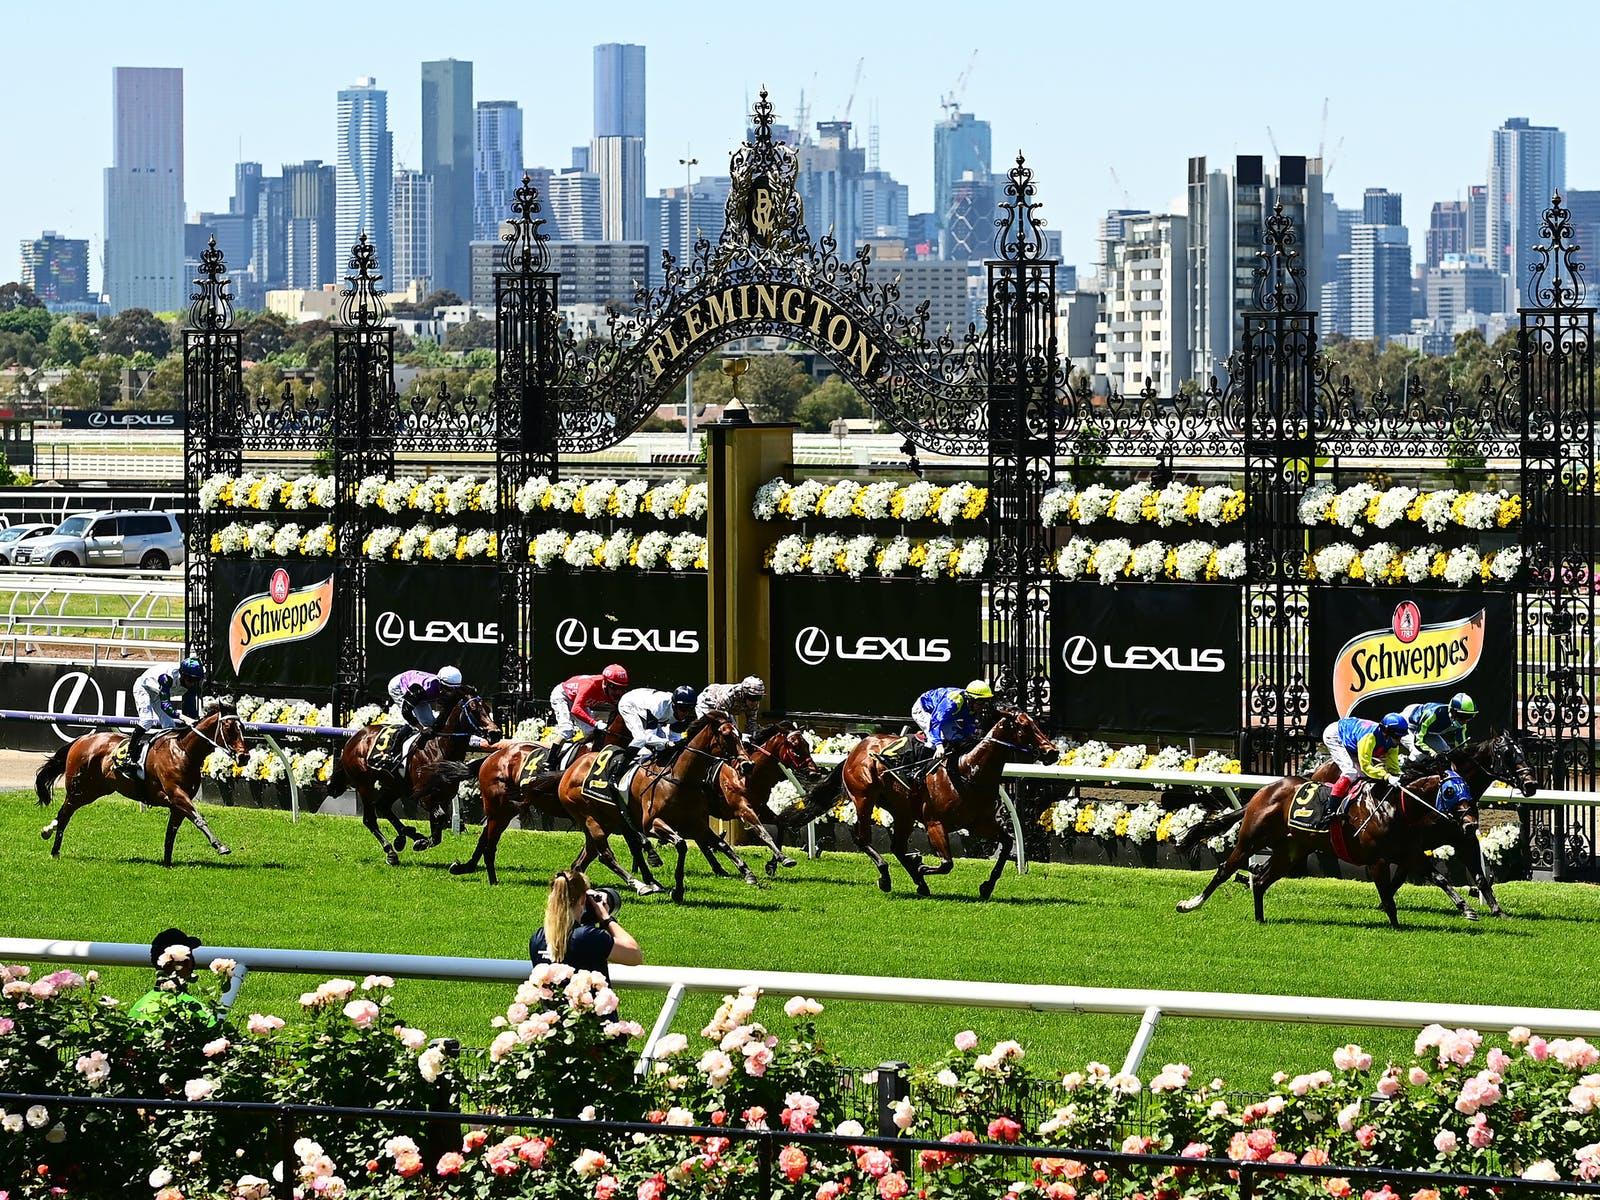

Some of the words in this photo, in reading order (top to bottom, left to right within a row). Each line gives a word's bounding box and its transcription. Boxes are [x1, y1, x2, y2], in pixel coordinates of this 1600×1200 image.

[645, 285, 880, 380] FLEMINGTON
[110, 415, 174, 425] LEXUS
[240, 597, 322, 646] Schweppes
[593, 627, 700, 653] LEXUS
[836, 636, 951, 662] LEXUS
[1104, 645, 1226, 672] LEXUS
[1350, 636, 1469, 692] Schweppes
[524, 753, 545, 776] 4
[593, 749, 613, 776] 9
[1295, 783, 1320, 806] 3
